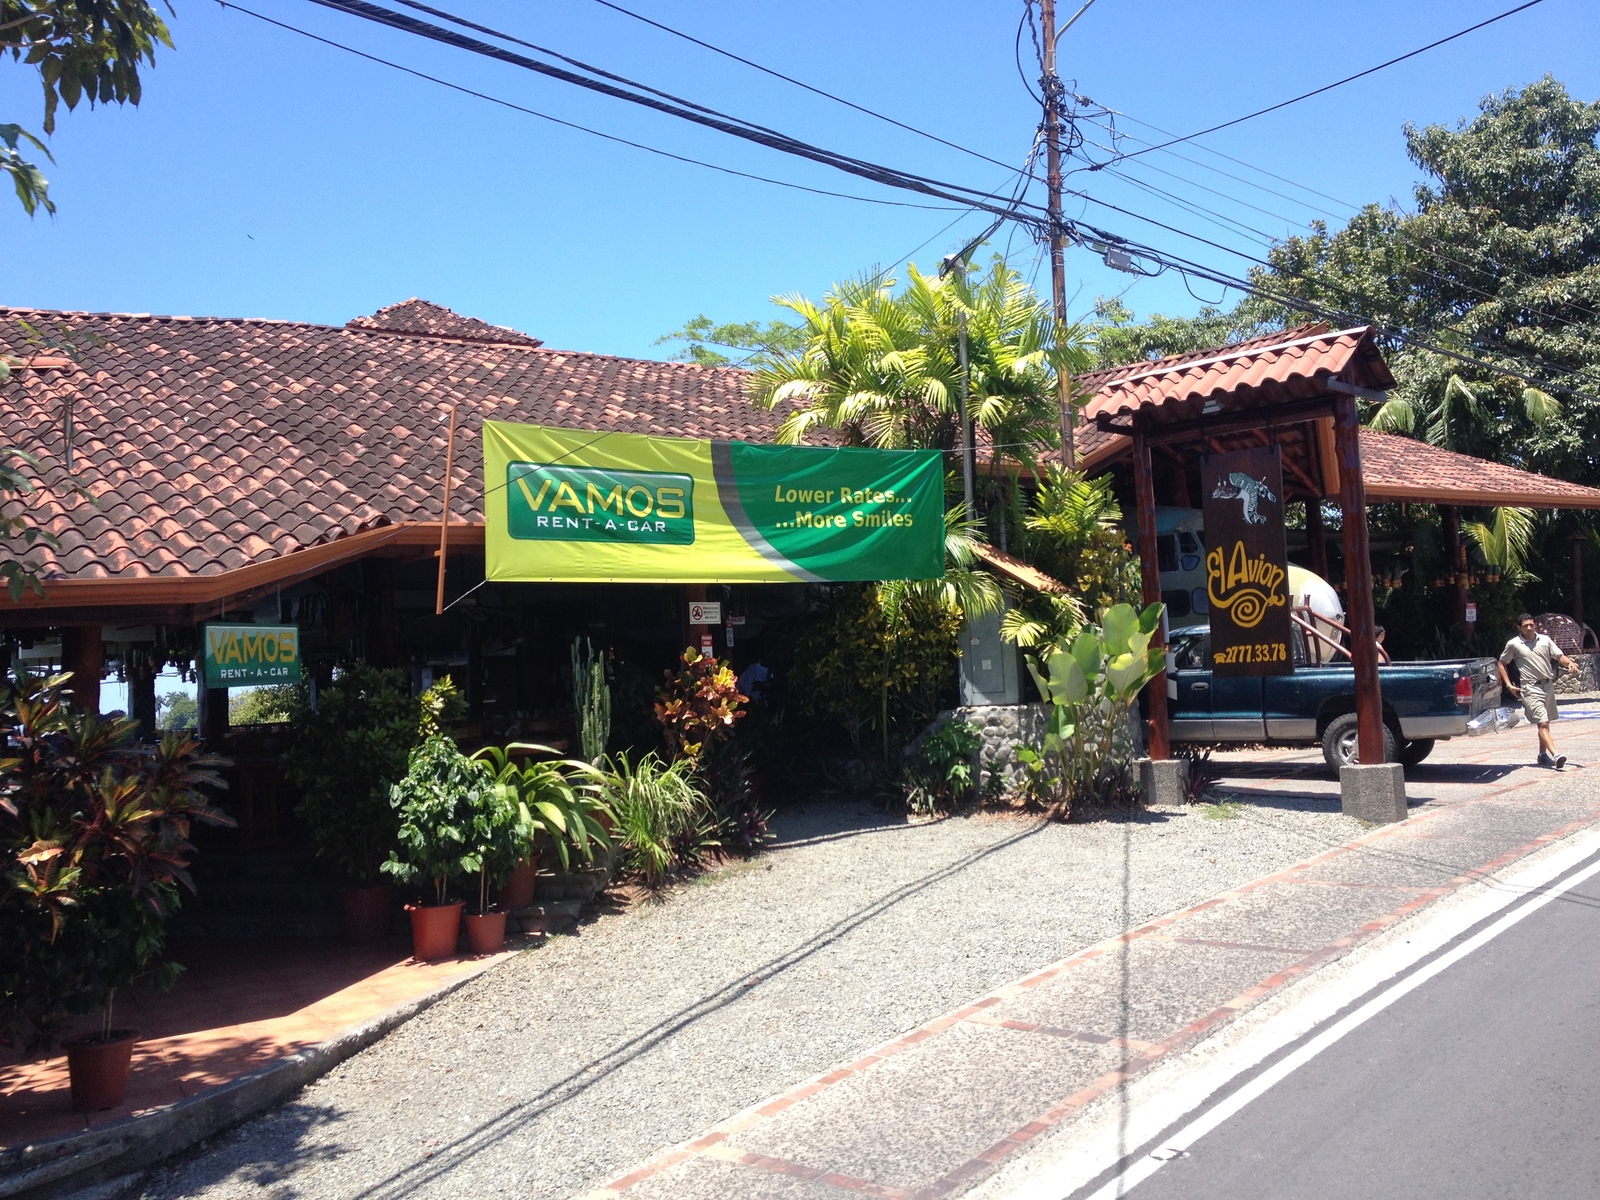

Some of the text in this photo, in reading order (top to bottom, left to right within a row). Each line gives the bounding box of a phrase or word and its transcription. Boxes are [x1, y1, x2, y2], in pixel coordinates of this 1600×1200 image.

[514, 477, 686, 519] VAMOS
[774, 485, 912, 504] Lower Rates...
[536, 515, 666, 532] RENT-A-CAR
[776, 510, 913, 528] ...More Smiles
[1227, 540, 1285, 589] Avion
[209, 631, 296, 665] VAMOS
[1225, 643, 1287, 663] 2777.33.78
